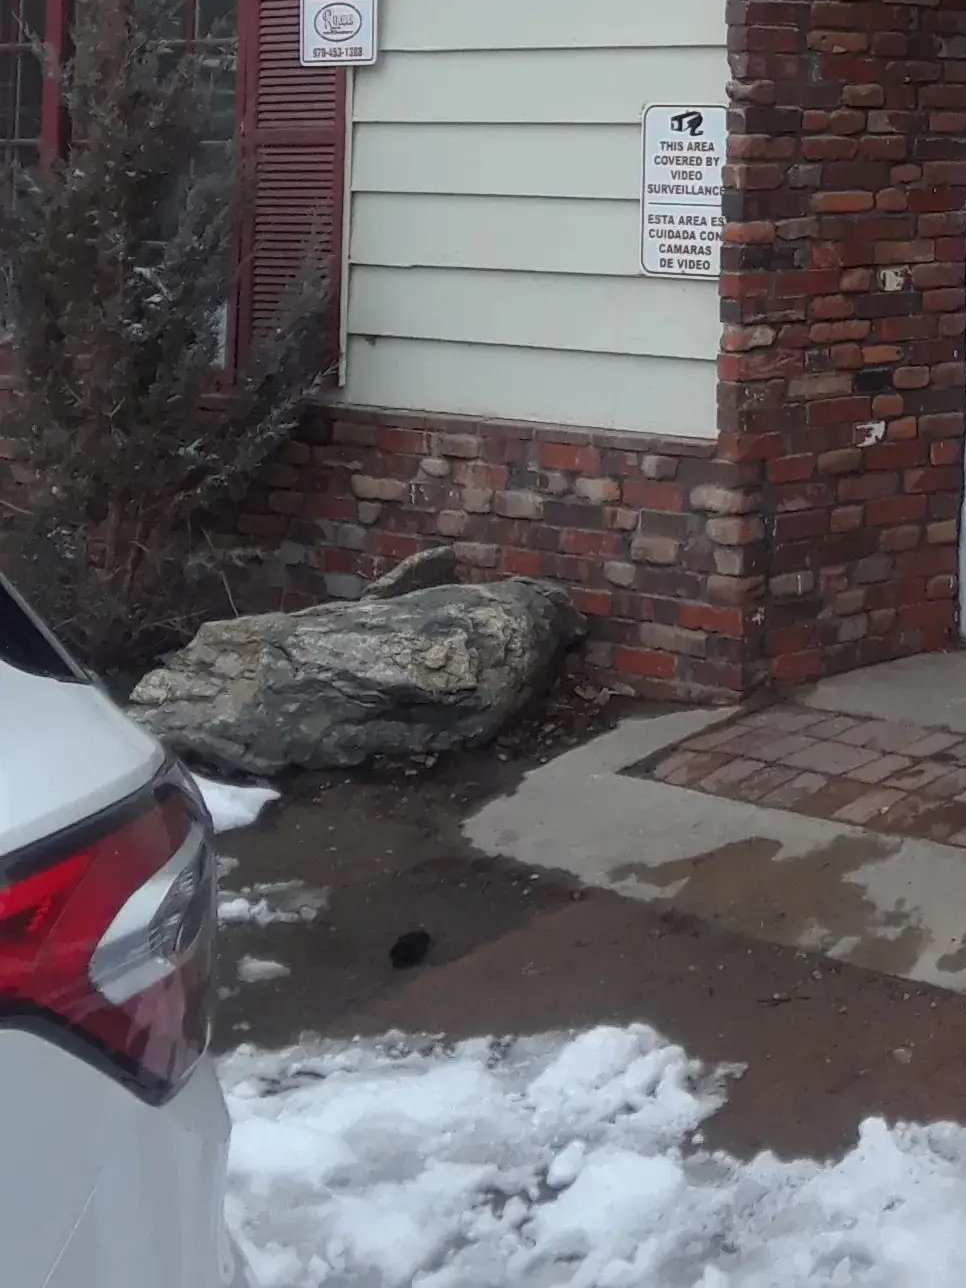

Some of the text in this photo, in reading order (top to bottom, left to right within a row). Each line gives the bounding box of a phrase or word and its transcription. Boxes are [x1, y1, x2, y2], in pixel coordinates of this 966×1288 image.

[659, 140, 715, 153] THIS AREA
[653, 155, 720, 167] COVERED BY
[670, 170, 703, 181] VIDEO
[647, 183, 725, 196] SURVEILLANCE
[647, 214, 725, 227] ESTA AREA ES
[648, 228, 696, 241] CUIDADA
[658, 243, 712, 256] CAMARAS
[659, 257, 711, 271] DE VIDEO
